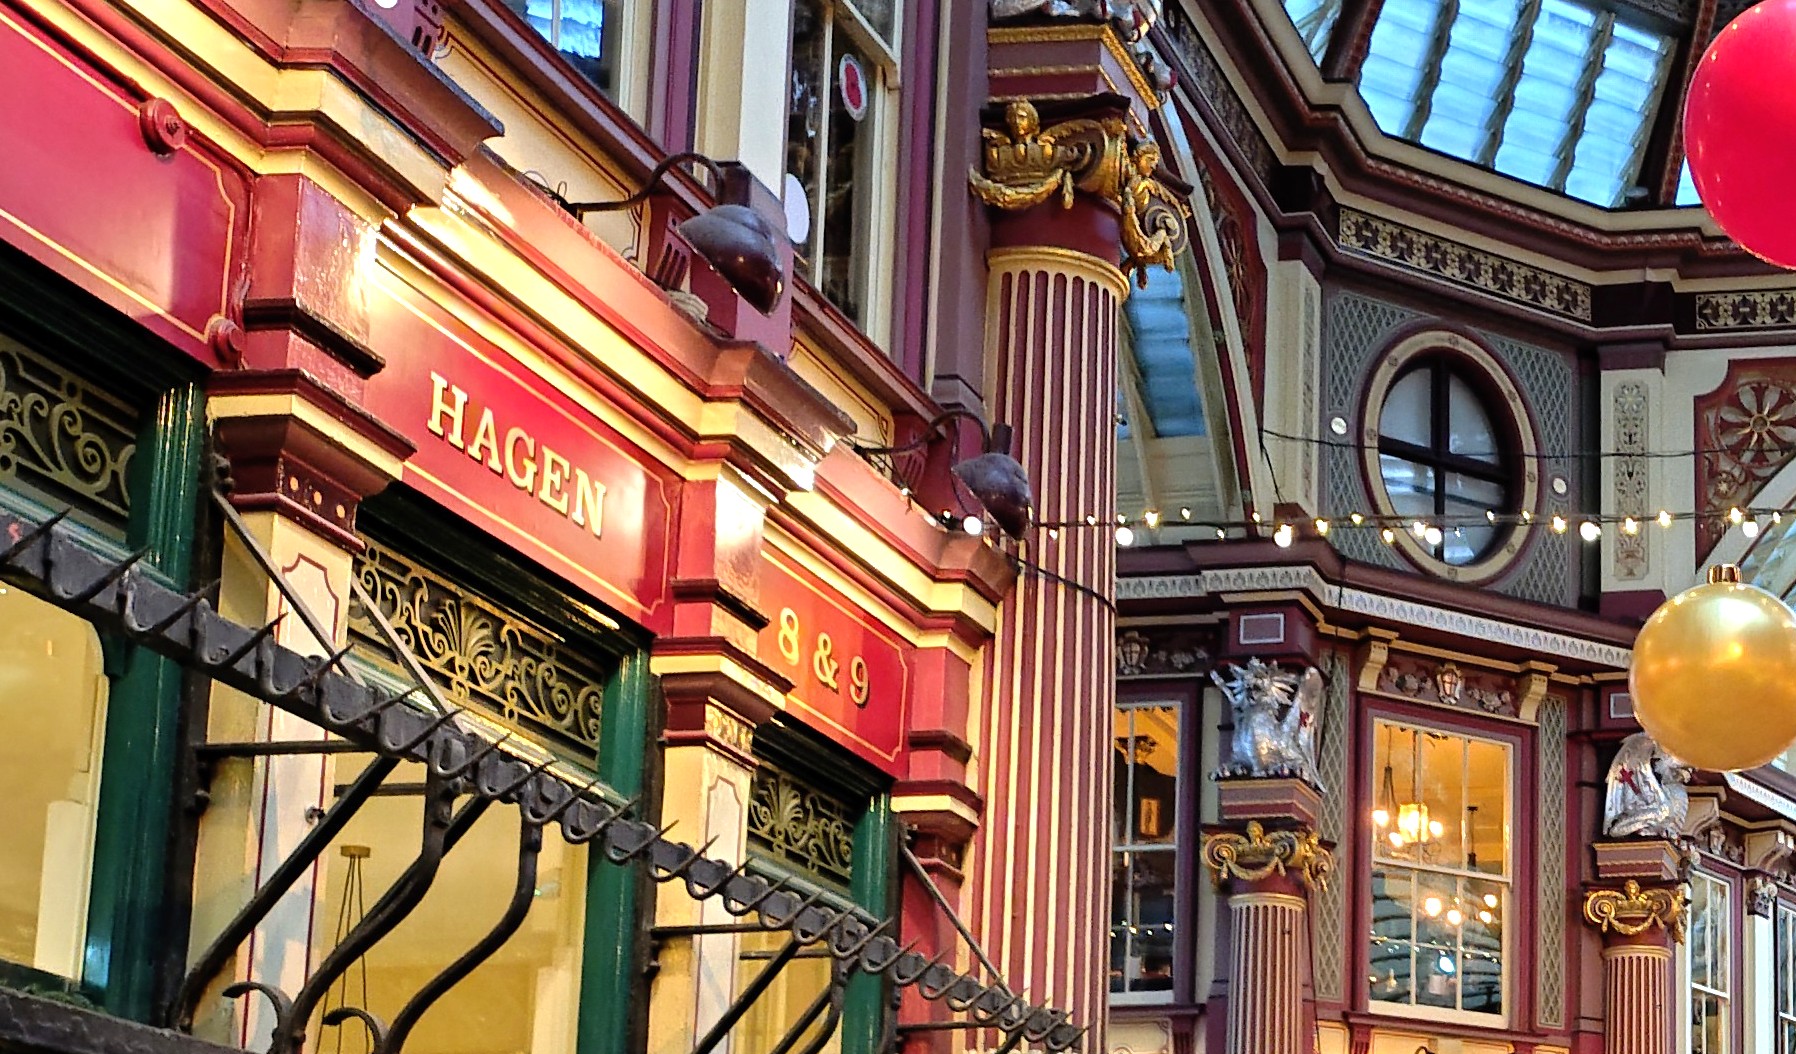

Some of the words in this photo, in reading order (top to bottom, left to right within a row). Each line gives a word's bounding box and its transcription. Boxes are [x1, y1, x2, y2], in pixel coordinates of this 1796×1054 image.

[427, 370, 606, 540] HAGEN
[778, 607, 799, 666] 8
[813, 632, 839, 694] &
[850, 656, 869, 708] 9
